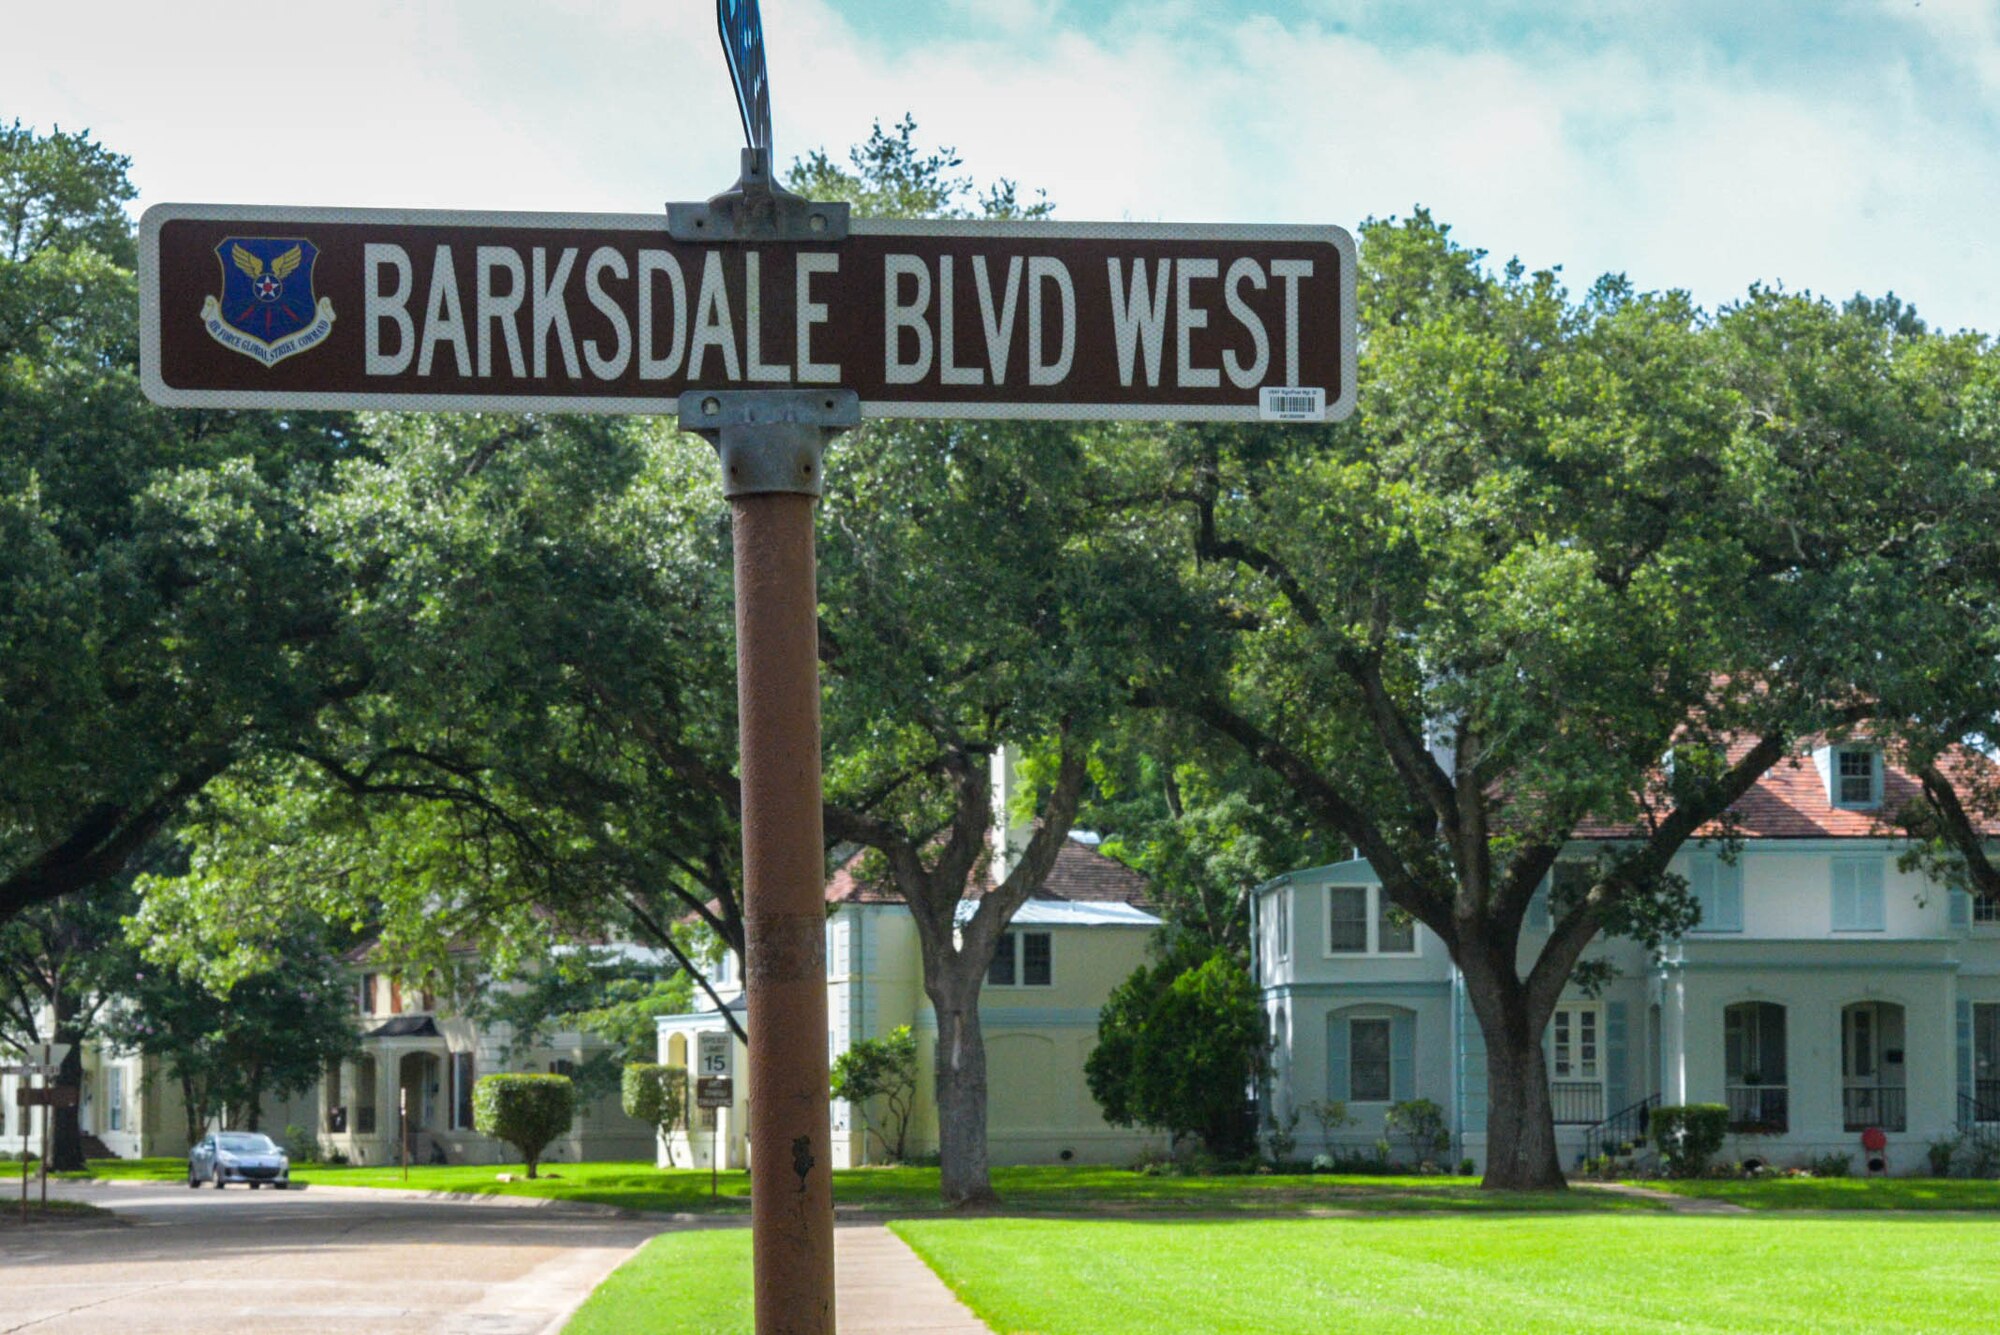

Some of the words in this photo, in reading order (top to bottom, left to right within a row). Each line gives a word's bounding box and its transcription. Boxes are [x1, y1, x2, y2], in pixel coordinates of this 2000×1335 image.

[364, 243, 841, 383] BARKSDALE
[884, 254, 1076, 386] BLVD
[1107, 257, 1314, 389] WEST
[208, 319, 221, 333] AIR
[218, 327, 240, 347] FORCE
[241, 339, 269, 361] GLOBAL
[269, 341, 298, 361] STRIKE
[299, 319, 329, 347] COMMAND
[702, 1036, 728, 1044] SPEED
[704, 1045, 725, 1053] LIMIT
[704, 1055, 726, 1071] 15
